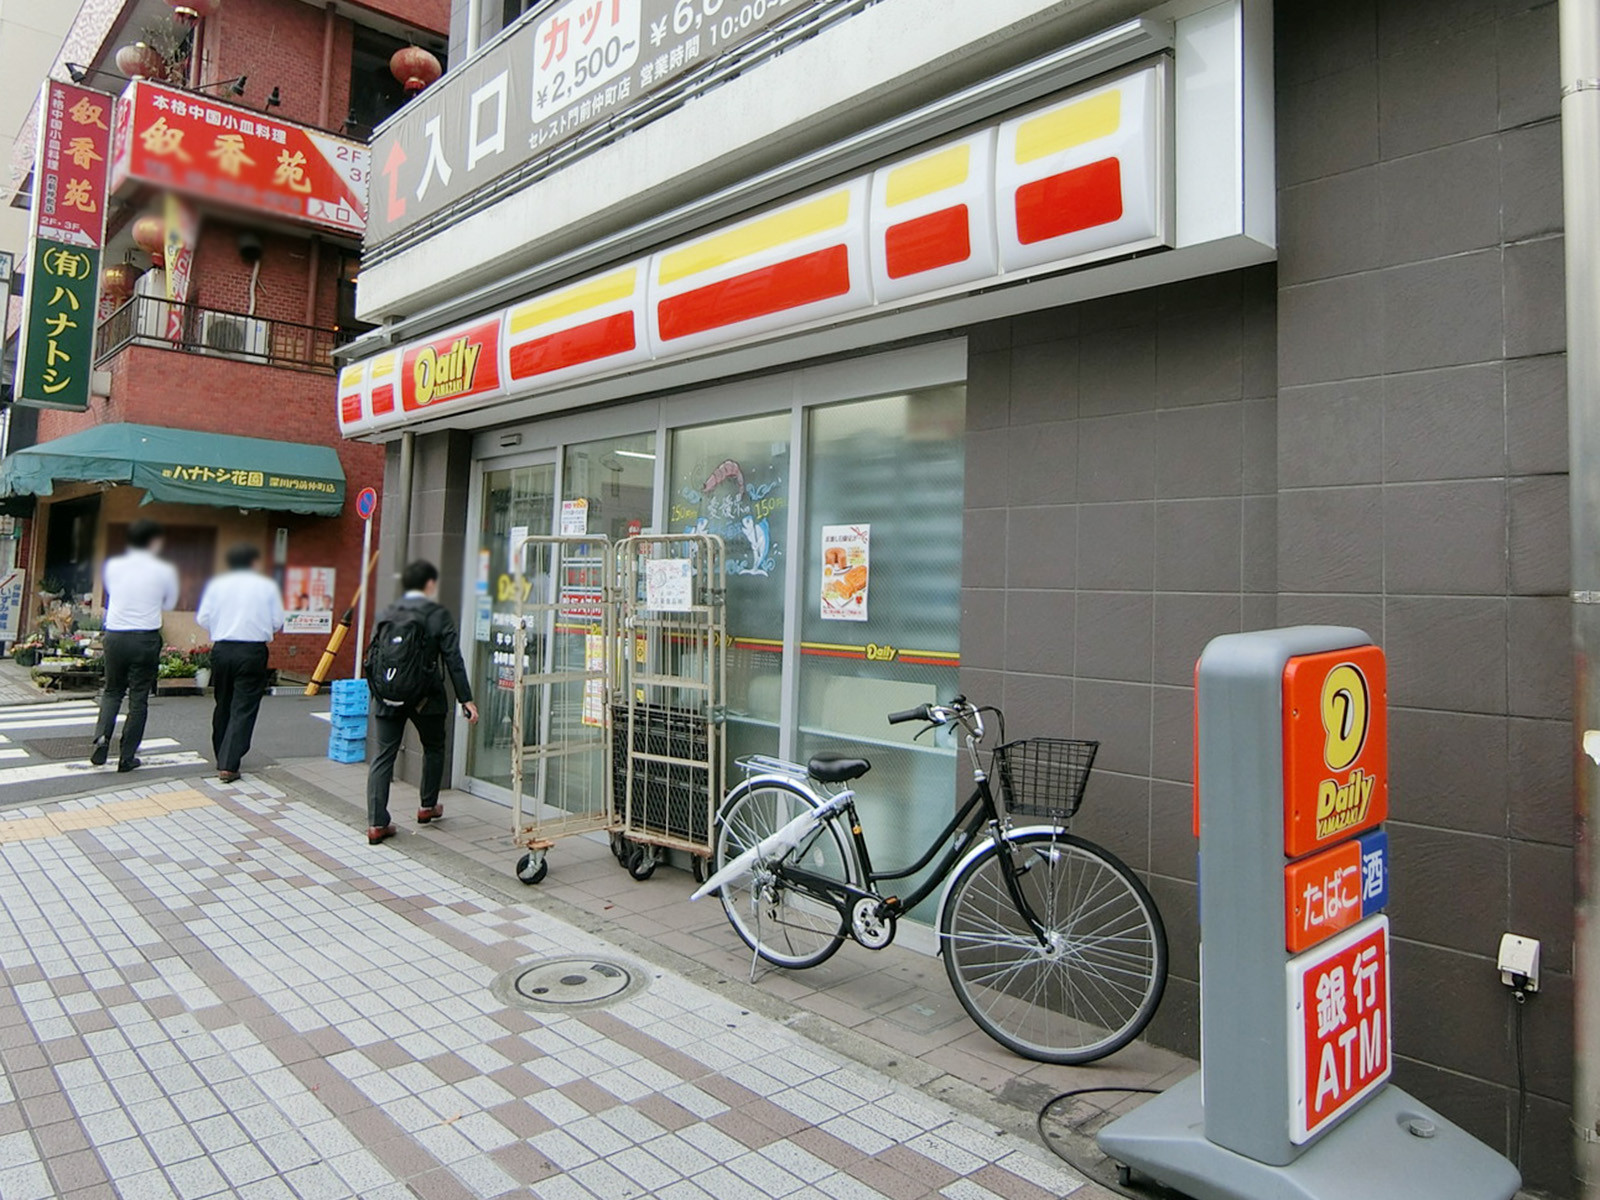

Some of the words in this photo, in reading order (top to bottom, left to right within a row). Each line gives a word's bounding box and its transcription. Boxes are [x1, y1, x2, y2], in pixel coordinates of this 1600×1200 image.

[640, 34, 700, 88] 営業時間
[711, 0, 795, 46] 10:00~
[152, 94, 287, 145] 本格中国小皿料理
[415, 69, 509, 202] 入口
[336, 146, 362, 163] 2F
[315, 200, 350, 222] 入口
[414, 336, 482, 405] Daily
[1318, 767, 1376, 824] Daily
[1303, 865, 1359, 931] たばこ
[1362, 849, 1384, 901] 酒
[1315, 945, 1379, 1039] 銀行
[1314, 1008, 1382, 1113] ATM
